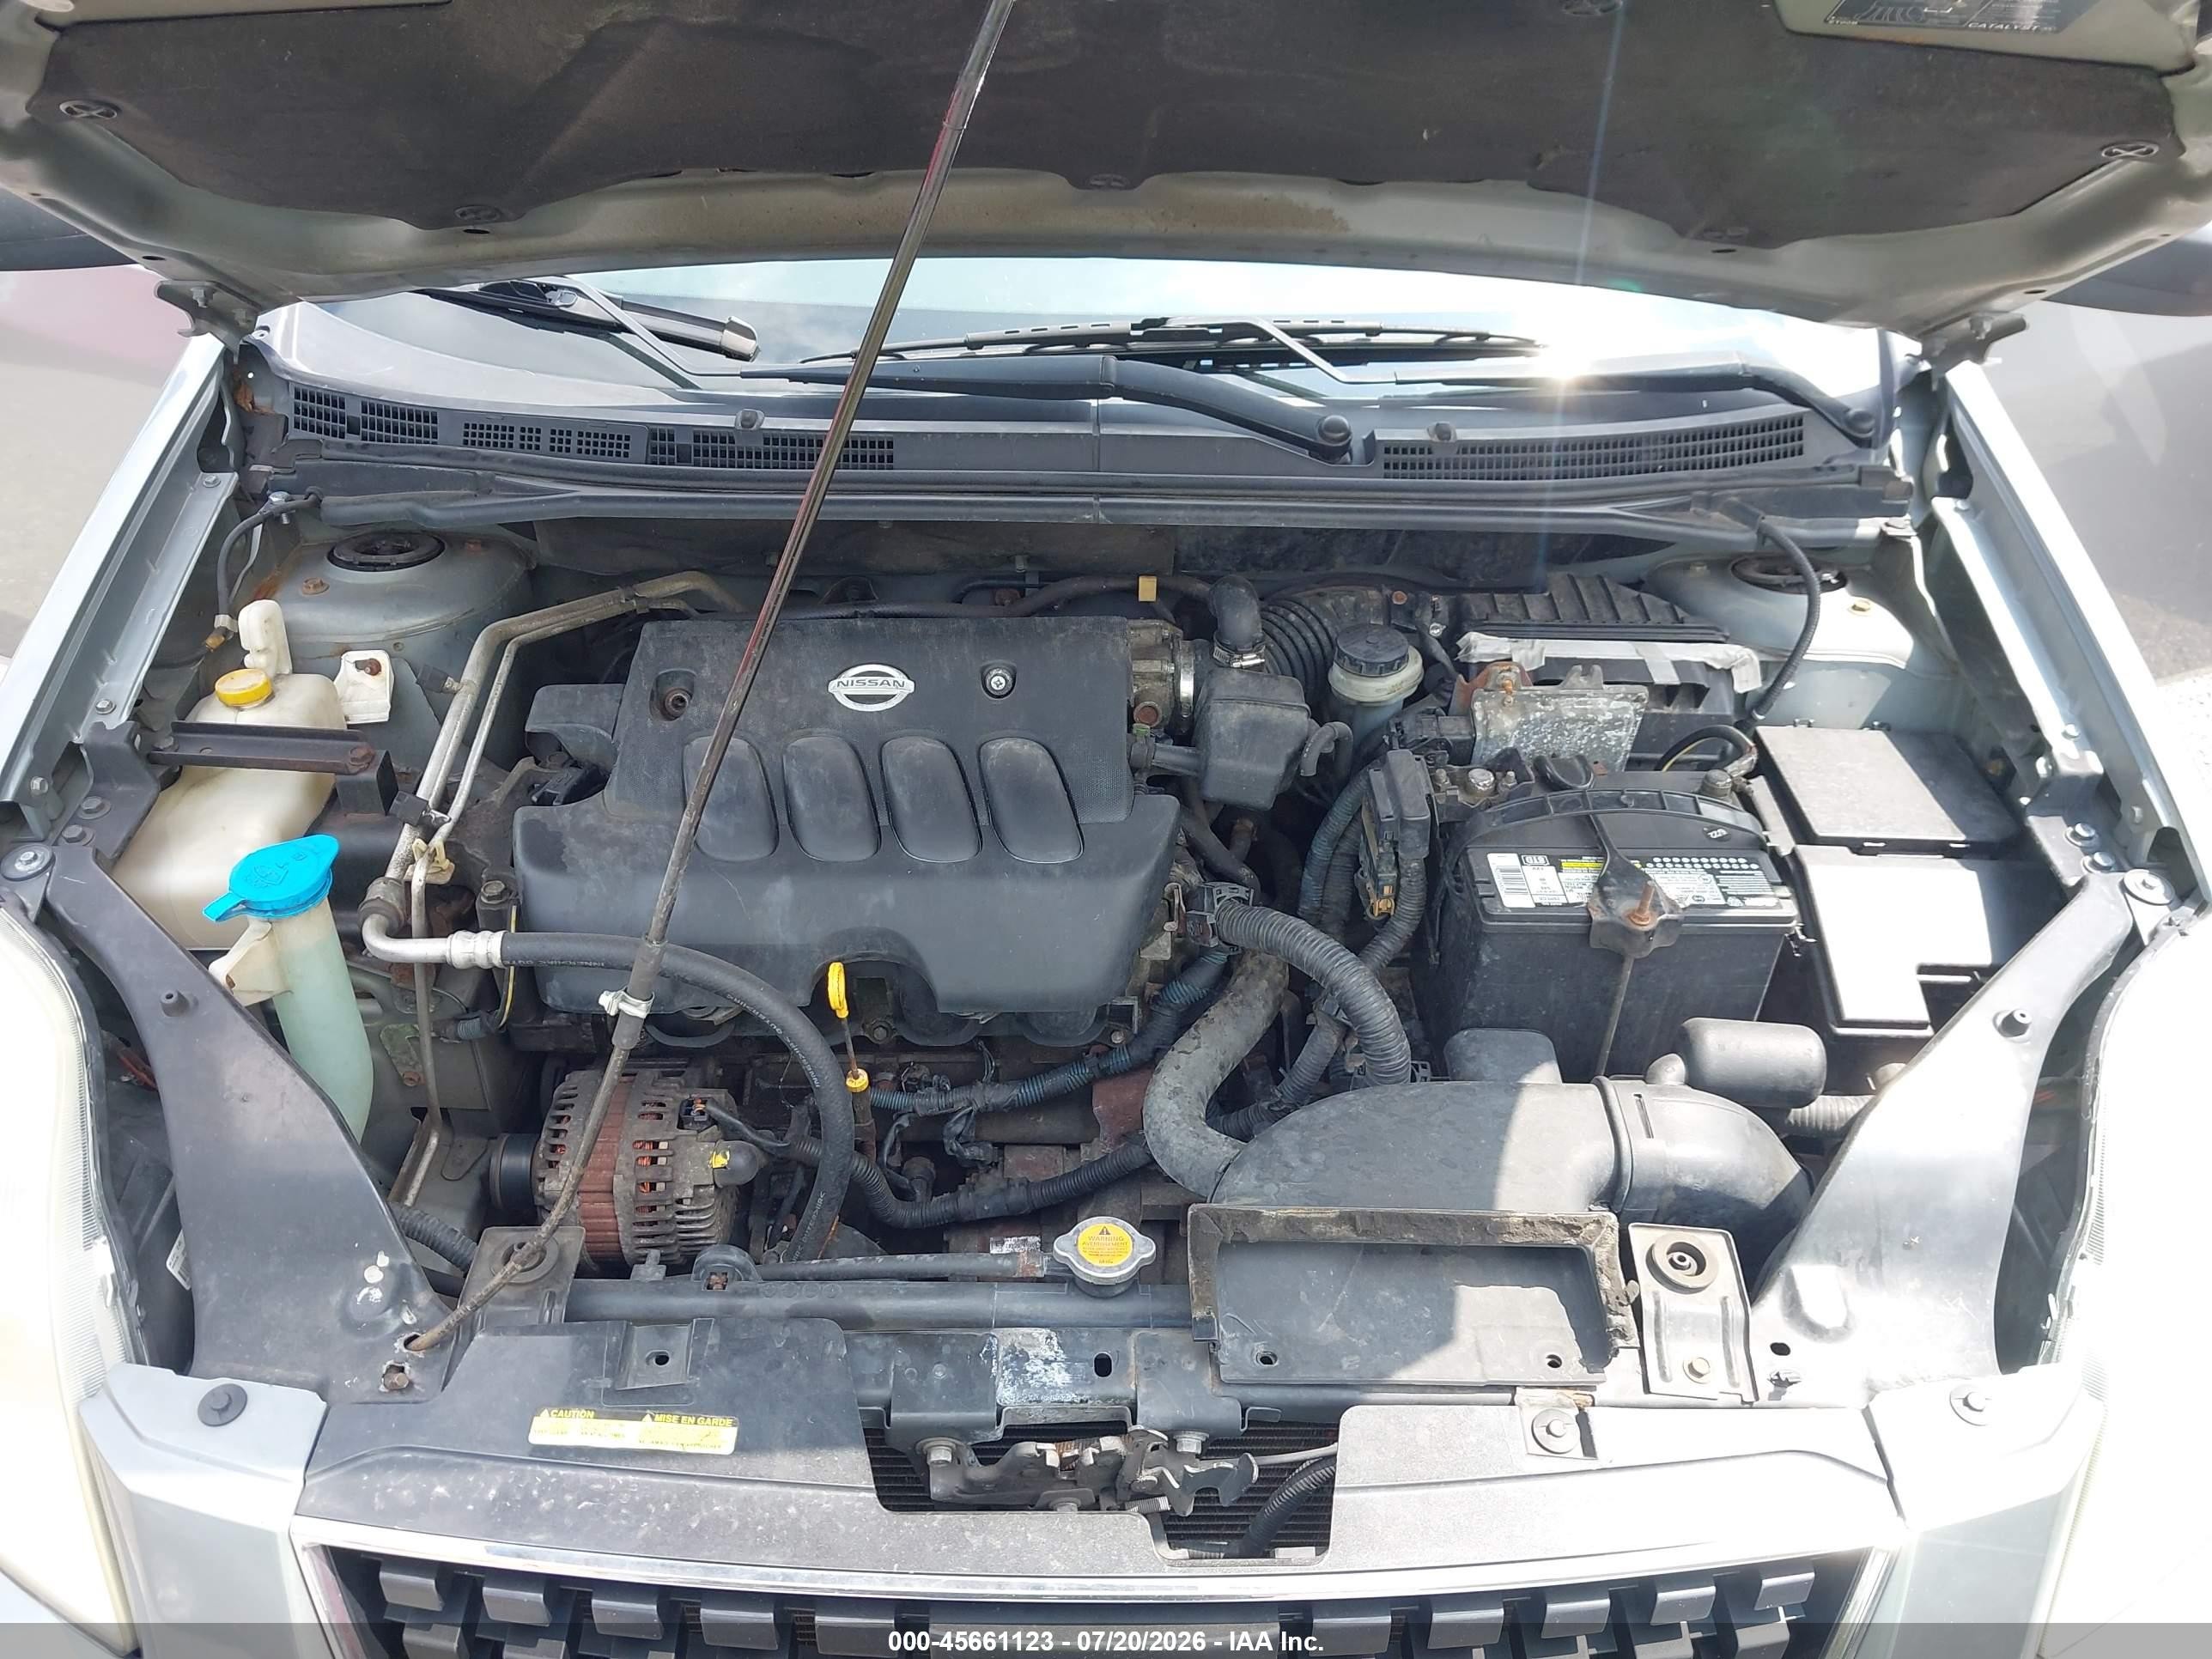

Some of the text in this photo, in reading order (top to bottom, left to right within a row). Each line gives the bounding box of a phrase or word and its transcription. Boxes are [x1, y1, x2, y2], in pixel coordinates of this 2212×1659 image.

[836, 678, 906, 688] NISSAN
[550, 1408, 595, 1419] CAUTION
[653, 1413, 734, 1427] MISE EN GARDE
